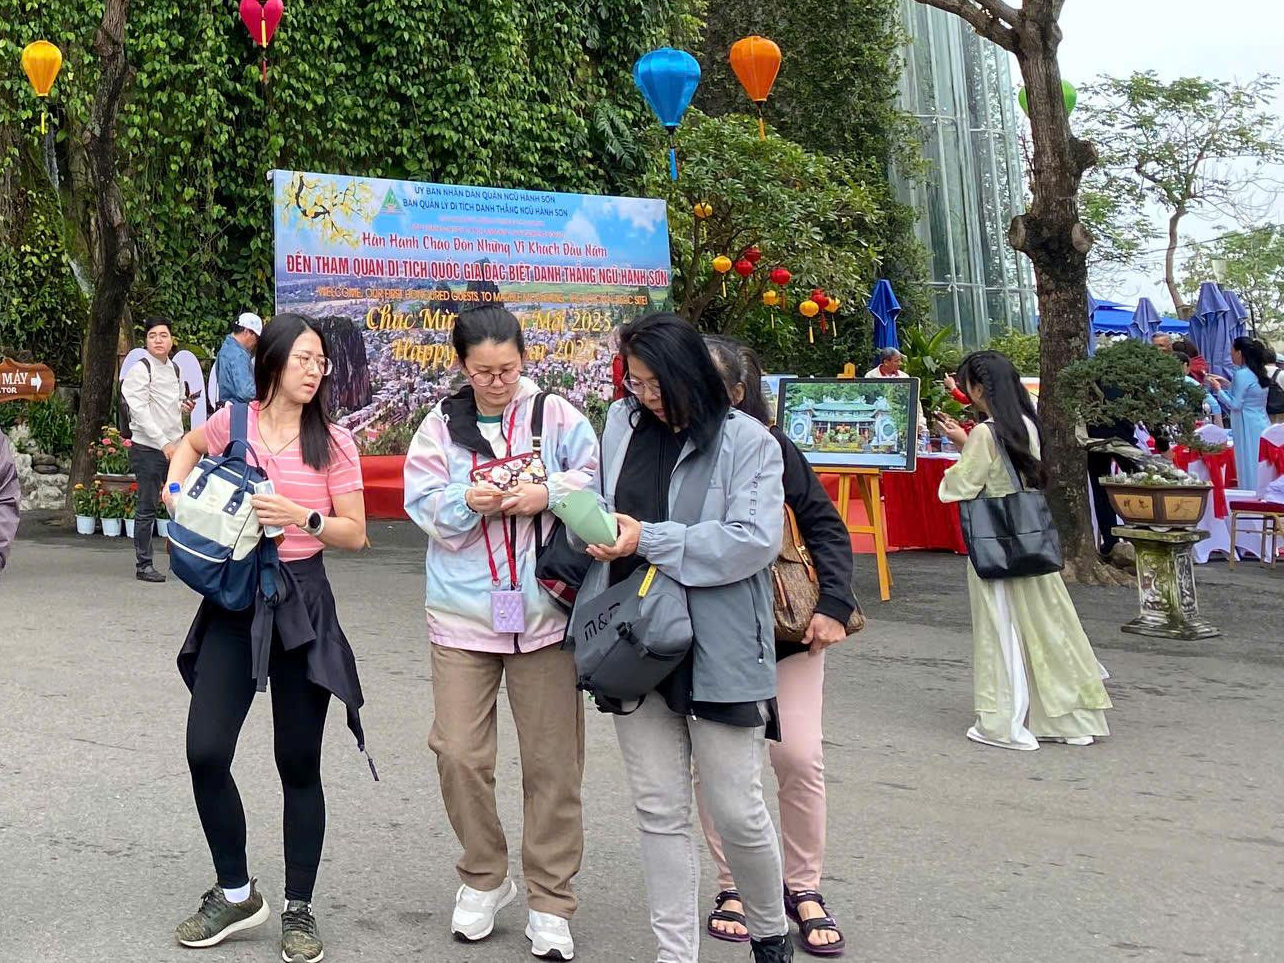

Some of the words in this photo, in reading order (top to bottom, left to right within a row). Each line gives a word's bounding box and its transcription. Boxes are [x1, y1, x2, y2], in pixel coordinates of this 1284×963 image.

[475, 203, 495, 212] DANH
[315, 255, 350, 275] THAM
[353, 257, 384, 278] QUAN
[387, 259, 400, 278] DI
[463, 262, 482, 281] GIA
[533, 265, 561, 283] DANH
[481, 291, 492, 302] TO
[571, 311, 613, 333] 2025
[392, 338, 458, 370] Happy
[2, 369, 29, 385] MÁY
